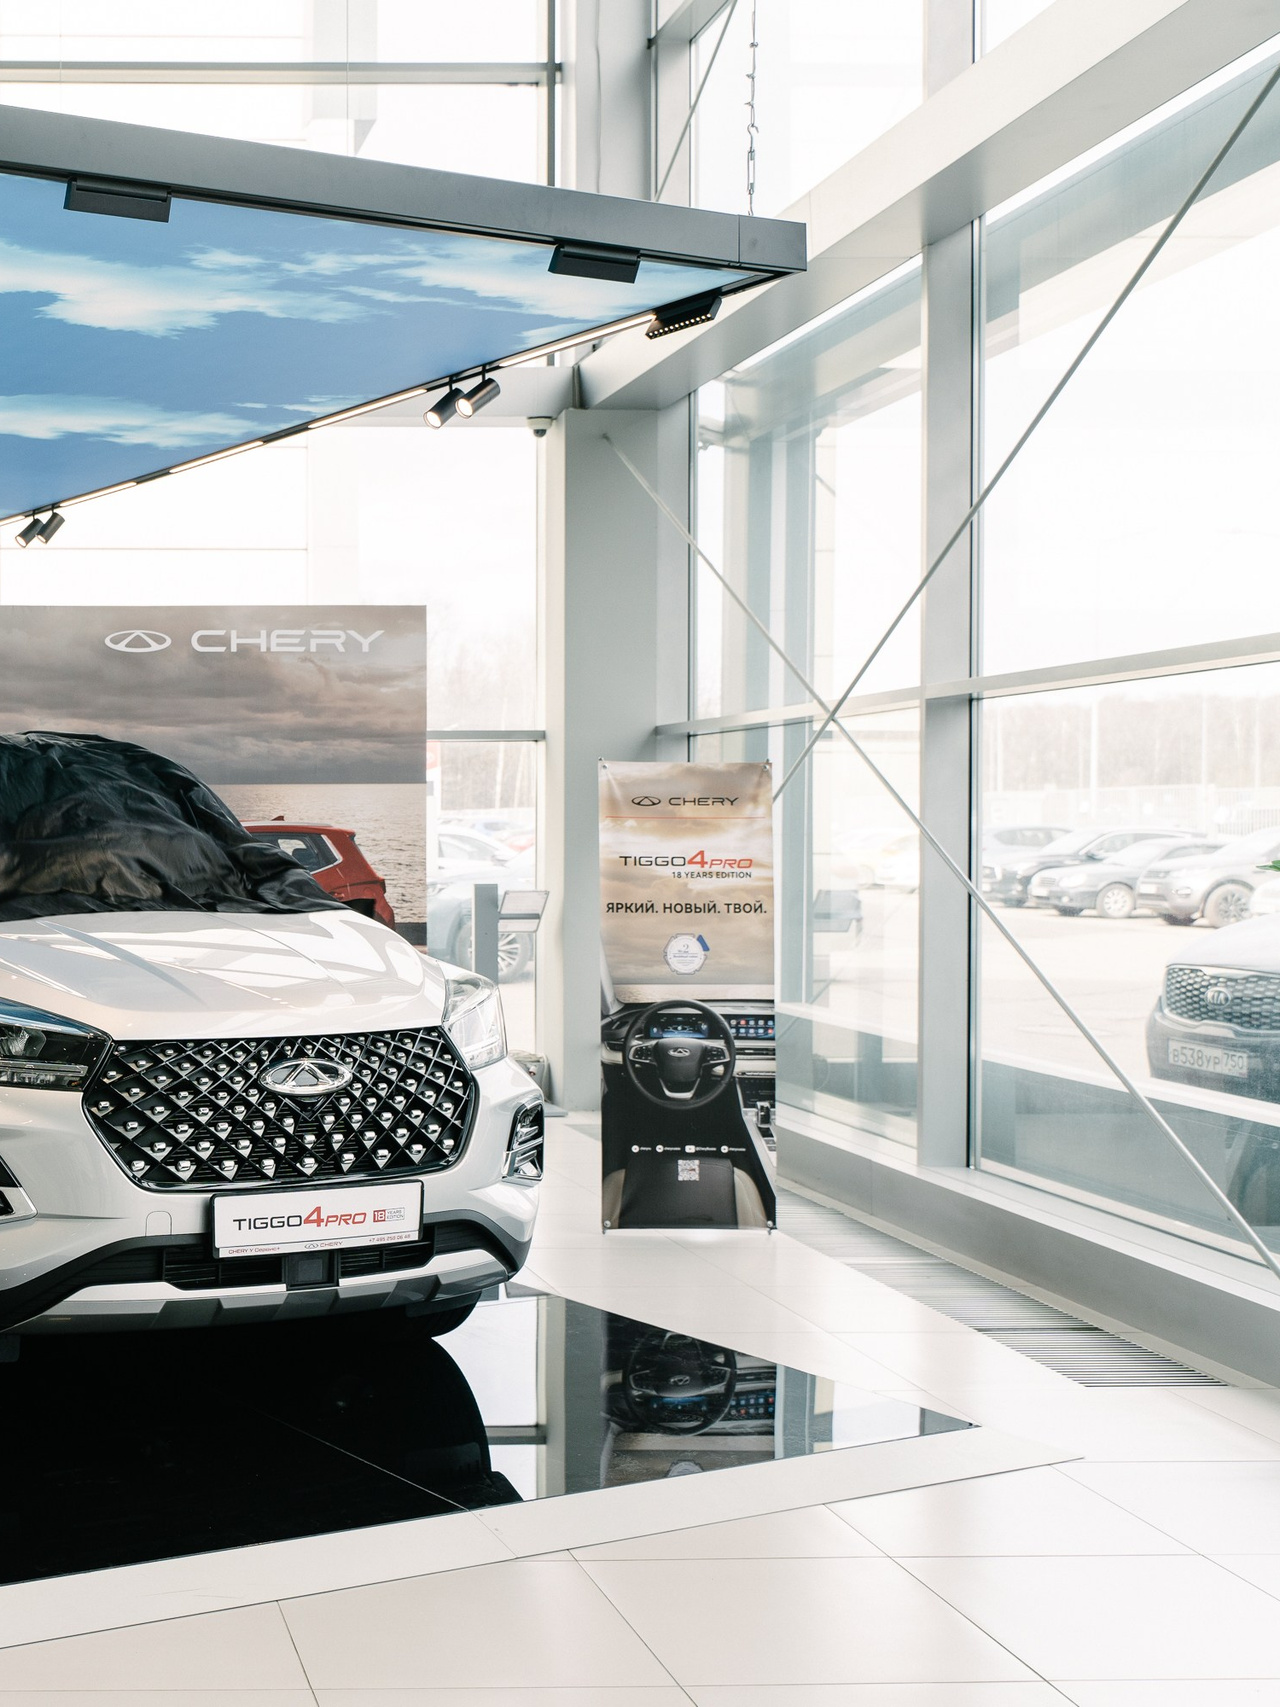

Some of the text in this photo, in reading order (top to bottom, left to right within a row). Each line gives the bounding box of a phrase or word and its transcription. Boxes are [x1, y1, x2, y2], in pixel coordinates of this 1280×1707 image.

[190, 629, 385, 653] CHERY
[668, 797, 739, 806] CHERY
[672, 871, 752, 879] 18 YEARS EDITION
[606, 900, 767, 914] ЯРКИЙ. НОВЫЙ. ТВОЙ.
[1206, 990, 1226, 1005] KIA
[1223, 1052, 1244, 1070] 750
[373, 1211, 386, 1221] 18
